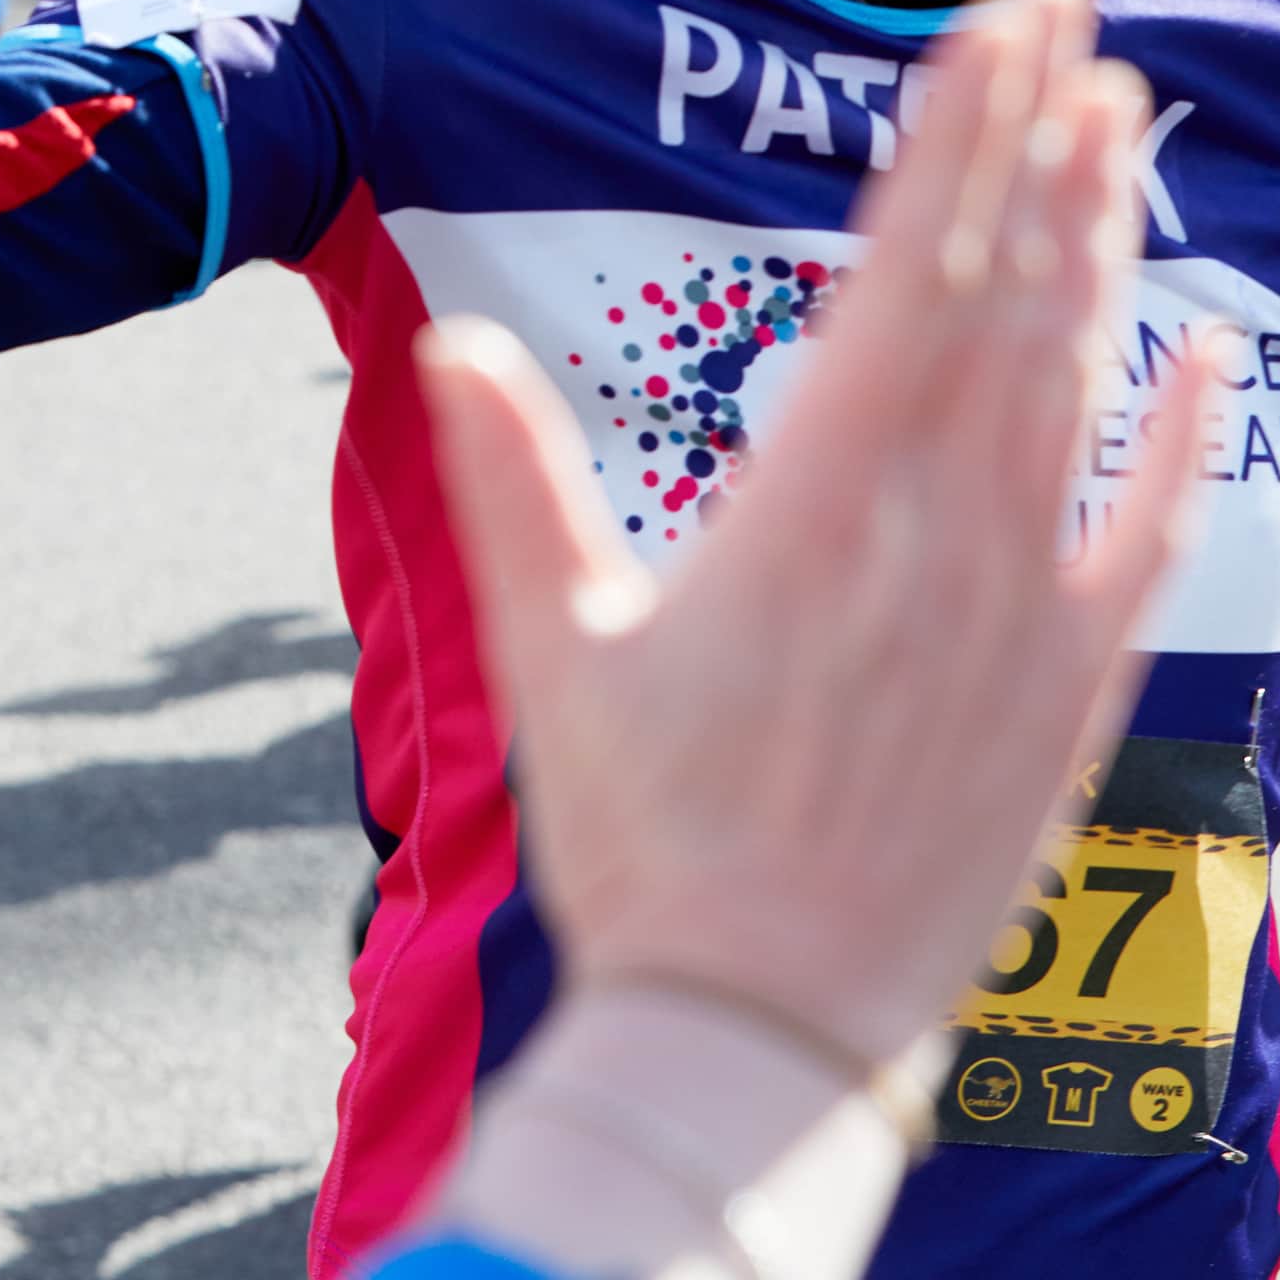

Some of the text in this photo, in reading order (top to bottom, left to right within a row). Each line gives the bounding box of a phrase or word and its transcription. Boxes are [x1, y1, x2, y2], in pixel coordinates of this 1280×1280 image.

[657, 4, 1196, 244] PATK
[1142, 1083, 1185, 1097] WAVE
[1151, 1098, 1169, 1122] 2
